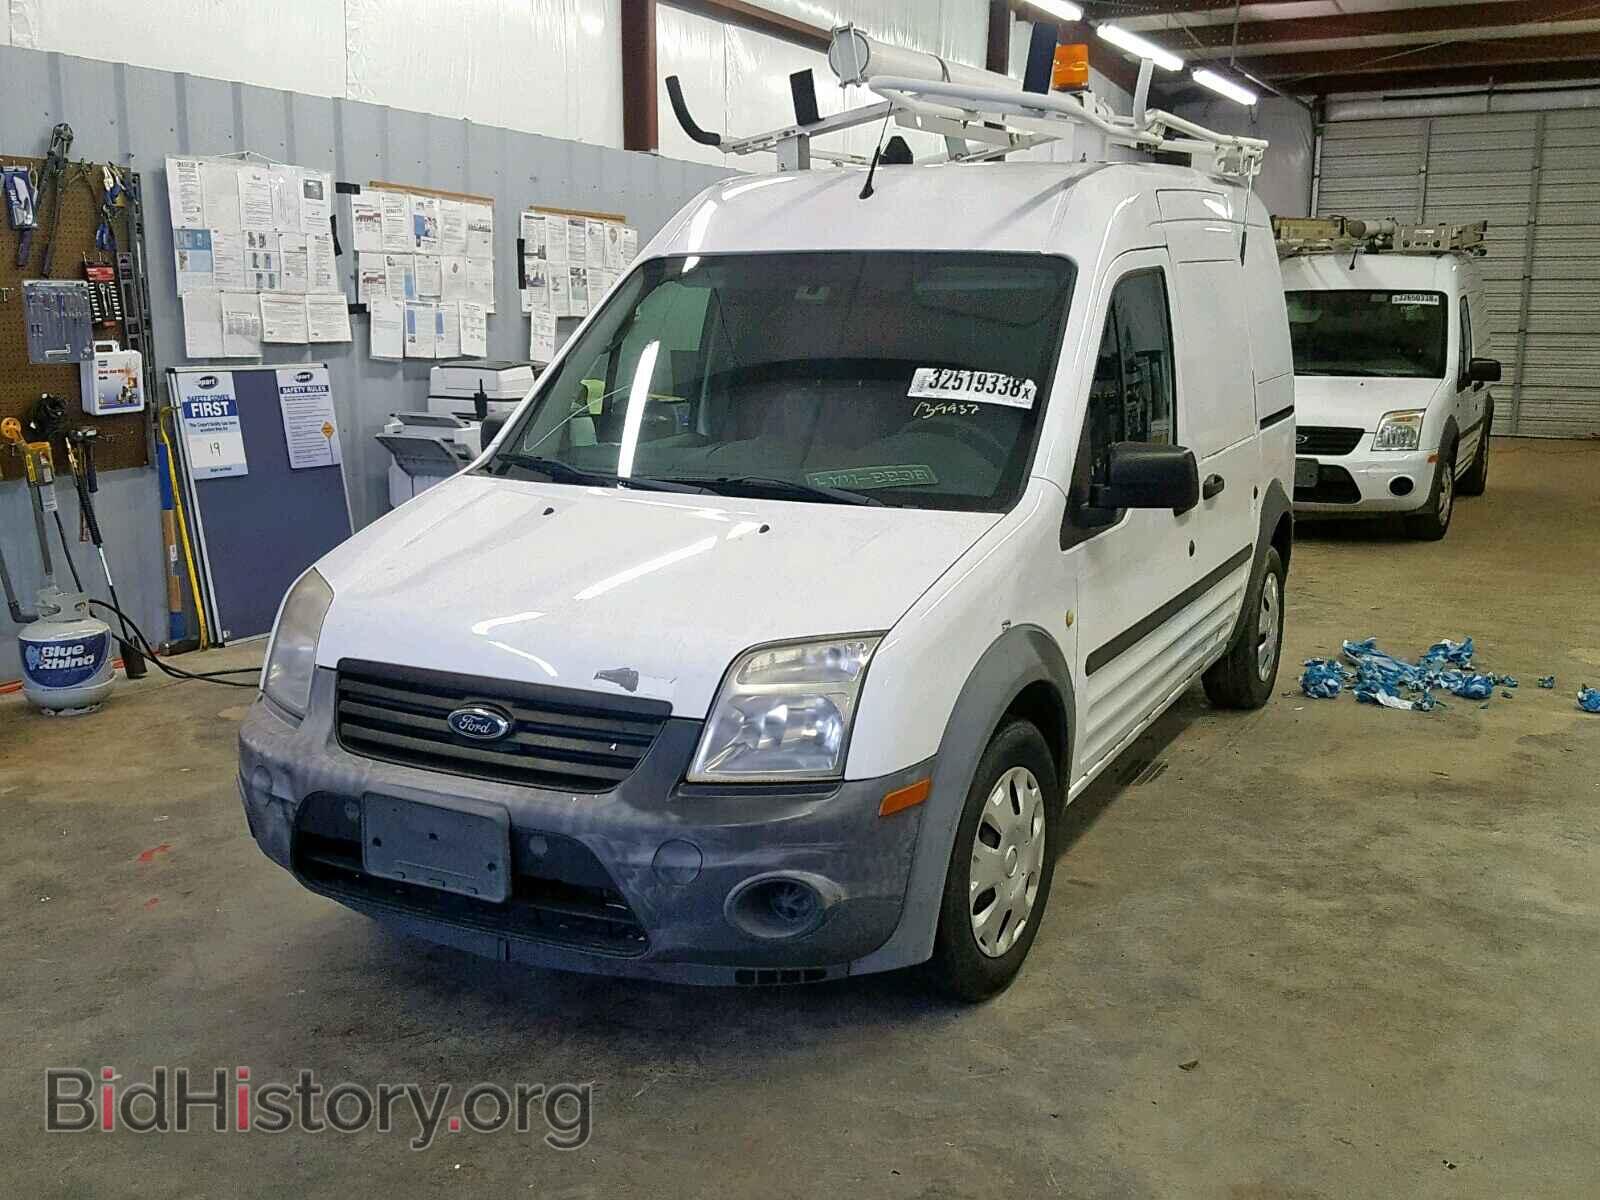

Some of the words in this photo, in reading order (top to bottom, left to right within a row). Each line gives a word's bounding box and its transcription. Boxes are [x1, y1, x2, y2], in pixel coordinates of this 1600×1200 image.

[929, 370, 1021, 397] 32519338
[191, 401, 229, 418] FIRST
[209, 441, 221, 457] 19
[42, 644, 84, 656] Blue
[39, 654, 95, 670] Rhino
[458, 714, 490, 733] Ford
